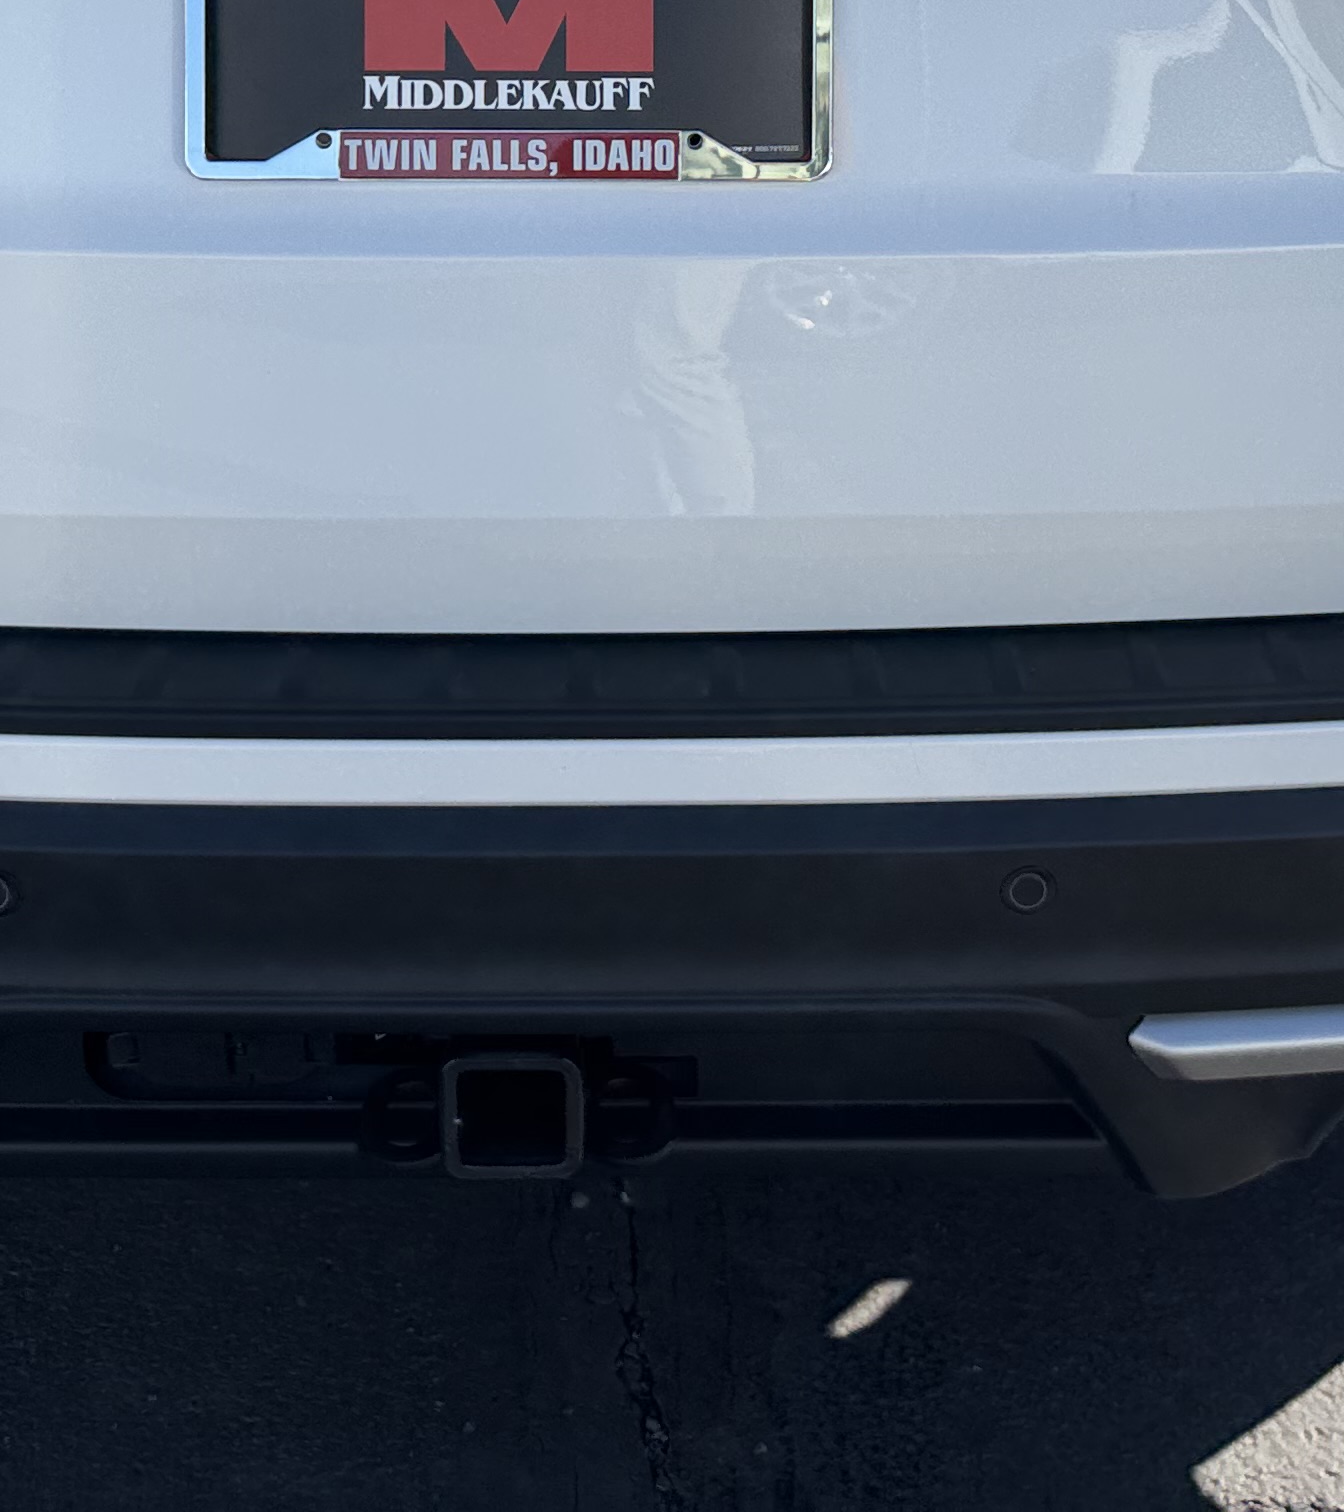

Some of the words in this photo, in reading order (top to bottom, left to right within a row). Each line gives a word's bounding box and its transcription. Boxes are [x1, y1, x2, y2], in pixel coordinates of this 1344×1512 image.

[362, 76, 655, 112] MIDDLEKAUFF
[344, 140, 436, 171] TWIN
[452, 140, 559, 178] FALLS,
[573, 139, 675, 170] IDAHO
